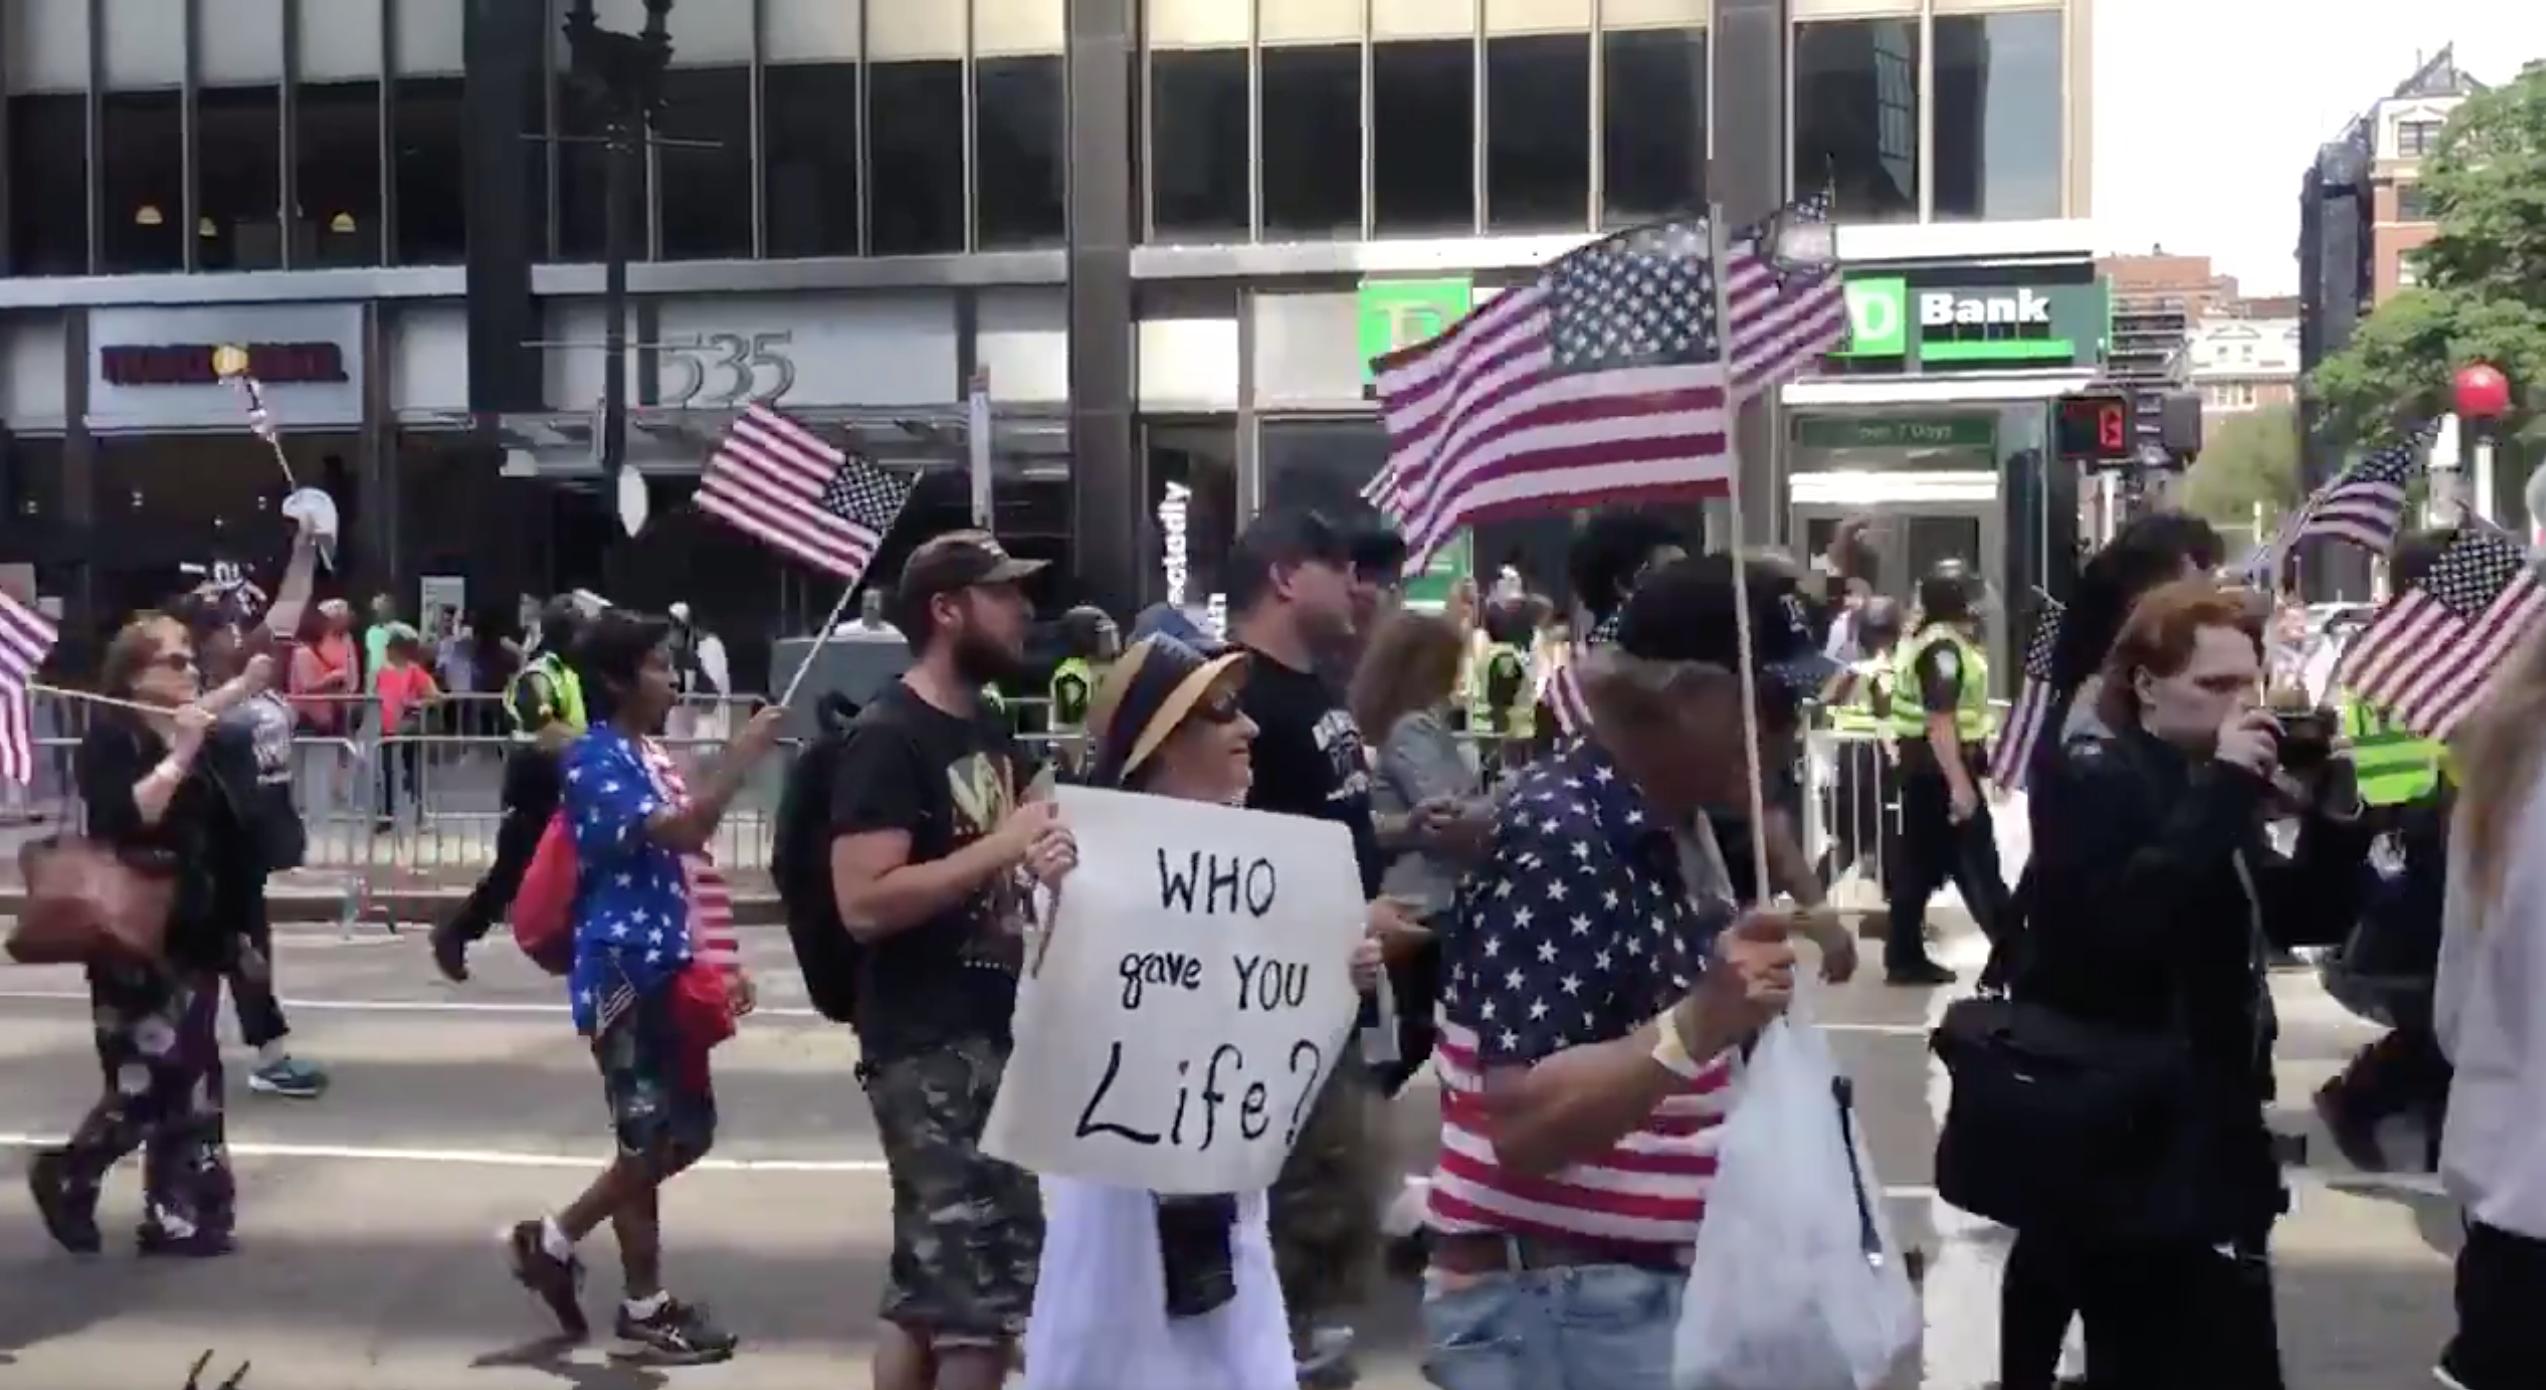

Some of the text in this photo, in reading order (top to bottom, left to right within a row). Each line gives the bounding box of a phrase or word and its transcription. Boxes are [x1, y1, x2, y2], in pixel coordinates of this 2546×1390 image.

[1920, 287, 2049, 325] Bank
[661, 330, 795, 404] 535
[1156, 847, 1276, 918] WHO
[1118, 951, 1309, 1011] gave YOU
[1074, 1038, 1322, 1152] Life?
